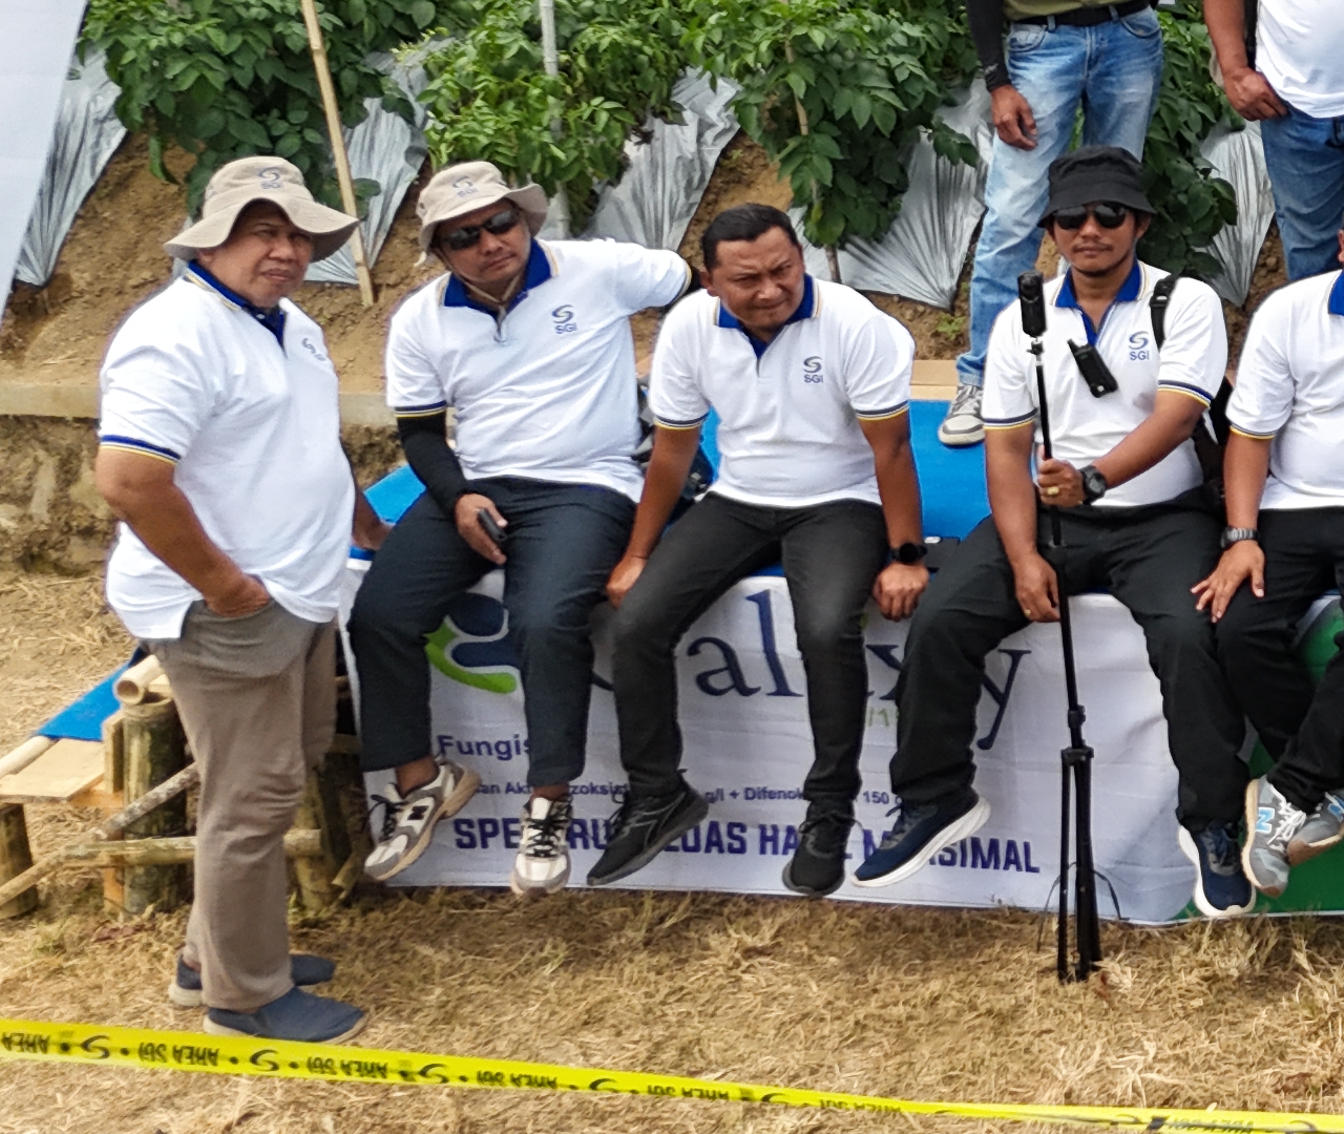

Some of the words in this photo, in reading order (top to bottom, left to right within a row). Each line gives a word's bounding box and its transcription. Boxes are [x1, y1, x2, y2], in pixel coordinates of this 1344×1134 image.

[1129, 350, 1150, 361] SGI
[804, 374, 824, 383] SGI
[437, 734, 529, 760] Fungis
[864, 791, 889, 804] 150
[1, 1032, 50, 1055] AREA
[138, 1042, 167, 1064] SGI
[172, 1043, 219, 1066] AREA
[307, 1056, 337, 1075] SGI
[340, 1060, 388, 1079] AREA
